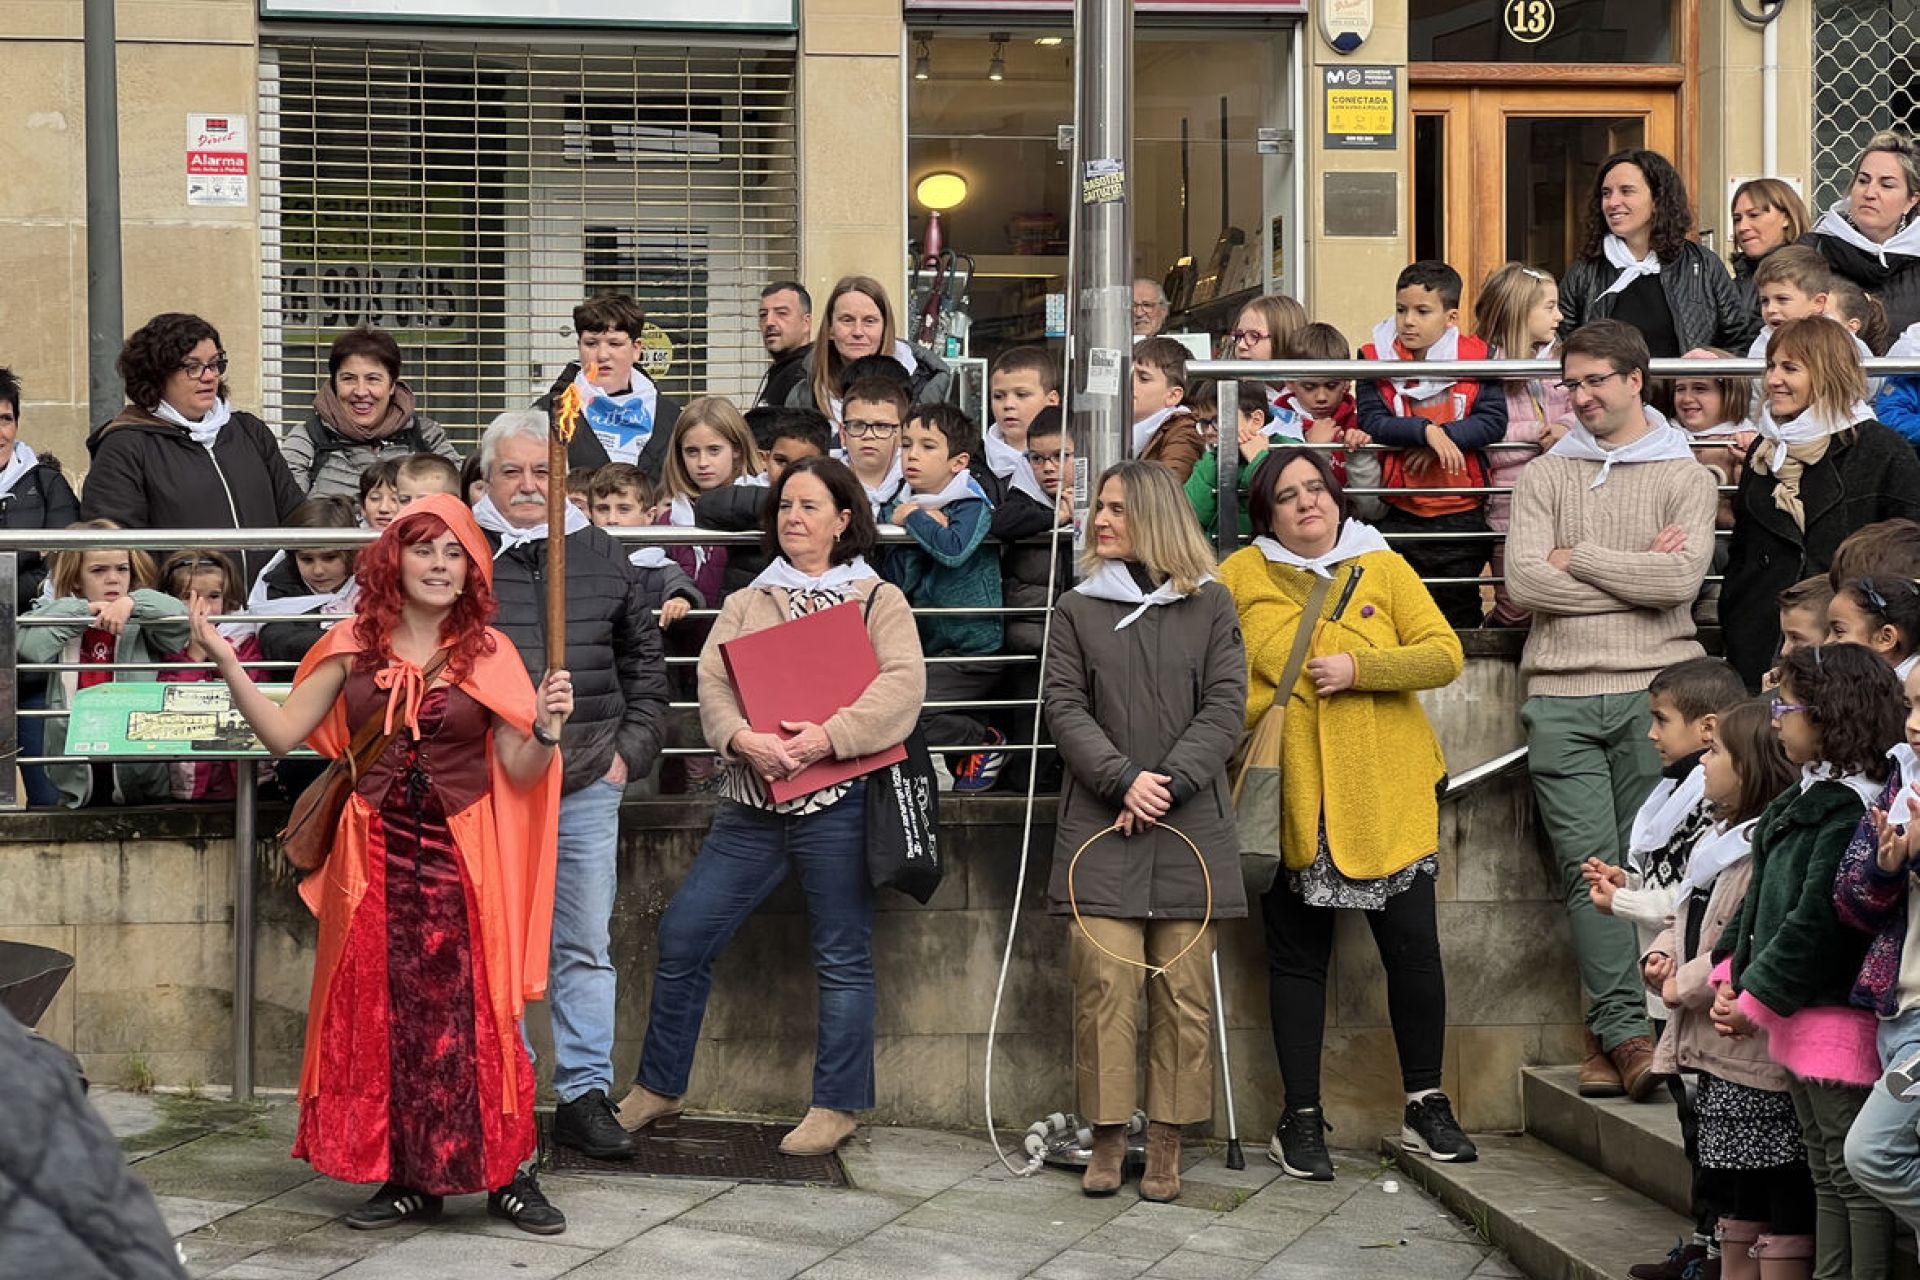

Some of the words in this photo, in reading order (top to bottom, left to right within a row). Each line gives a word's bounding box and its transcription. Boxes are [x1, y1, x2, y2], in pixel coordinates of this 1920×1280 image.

[1513, 0, 1545, 33] 13
[1332, 96, 1388, 105] CONECTADA
[191, 153, 245, 167] Alarma
